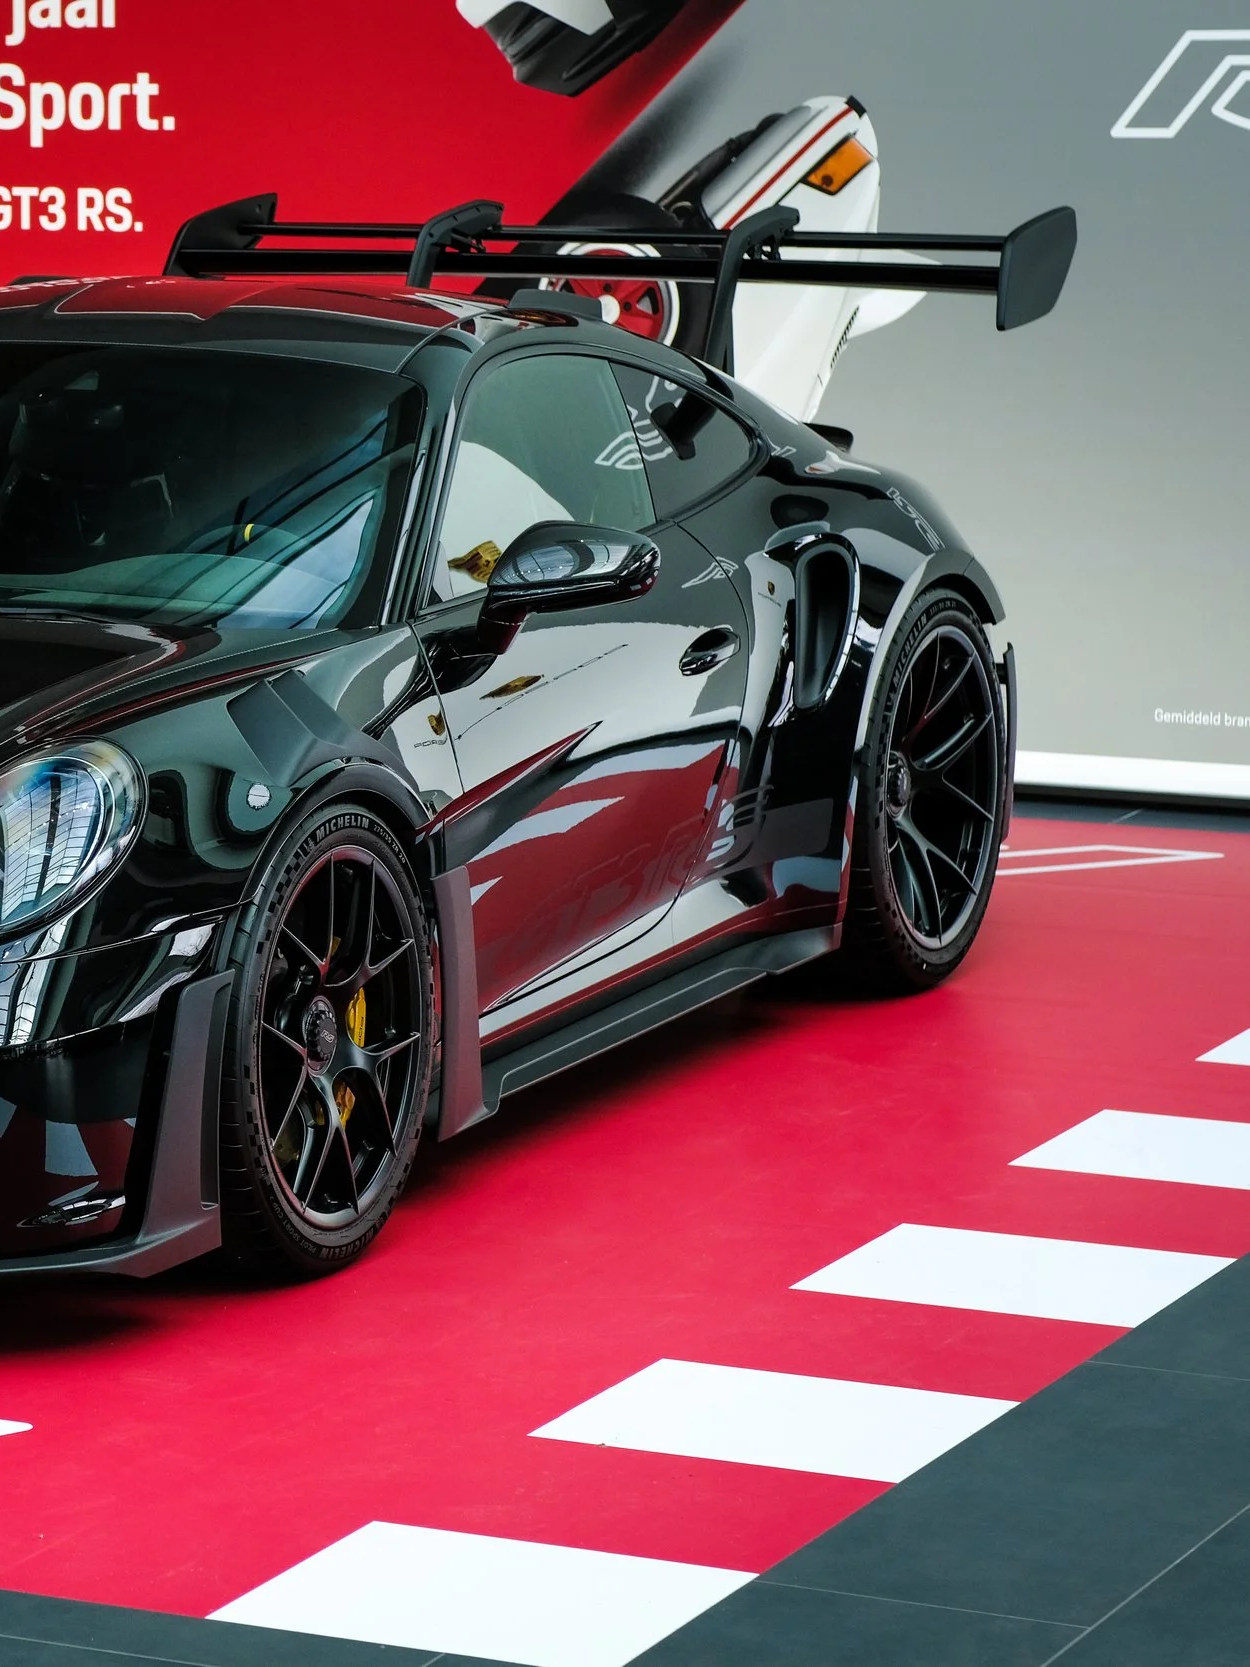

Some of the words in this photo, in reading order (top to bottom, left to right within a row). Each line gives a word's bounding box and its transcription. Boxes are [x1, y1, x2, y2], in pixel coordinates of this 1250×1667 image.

[76, 188, 143, 233] RS.
[892, 613, 928, 688] MICHELIN
[1154, 707, 1221, 725] Gemiddeld
[315, 814, 370, 843] MICHELIN
[319, 1228, 375, 1259] MICHELIN
